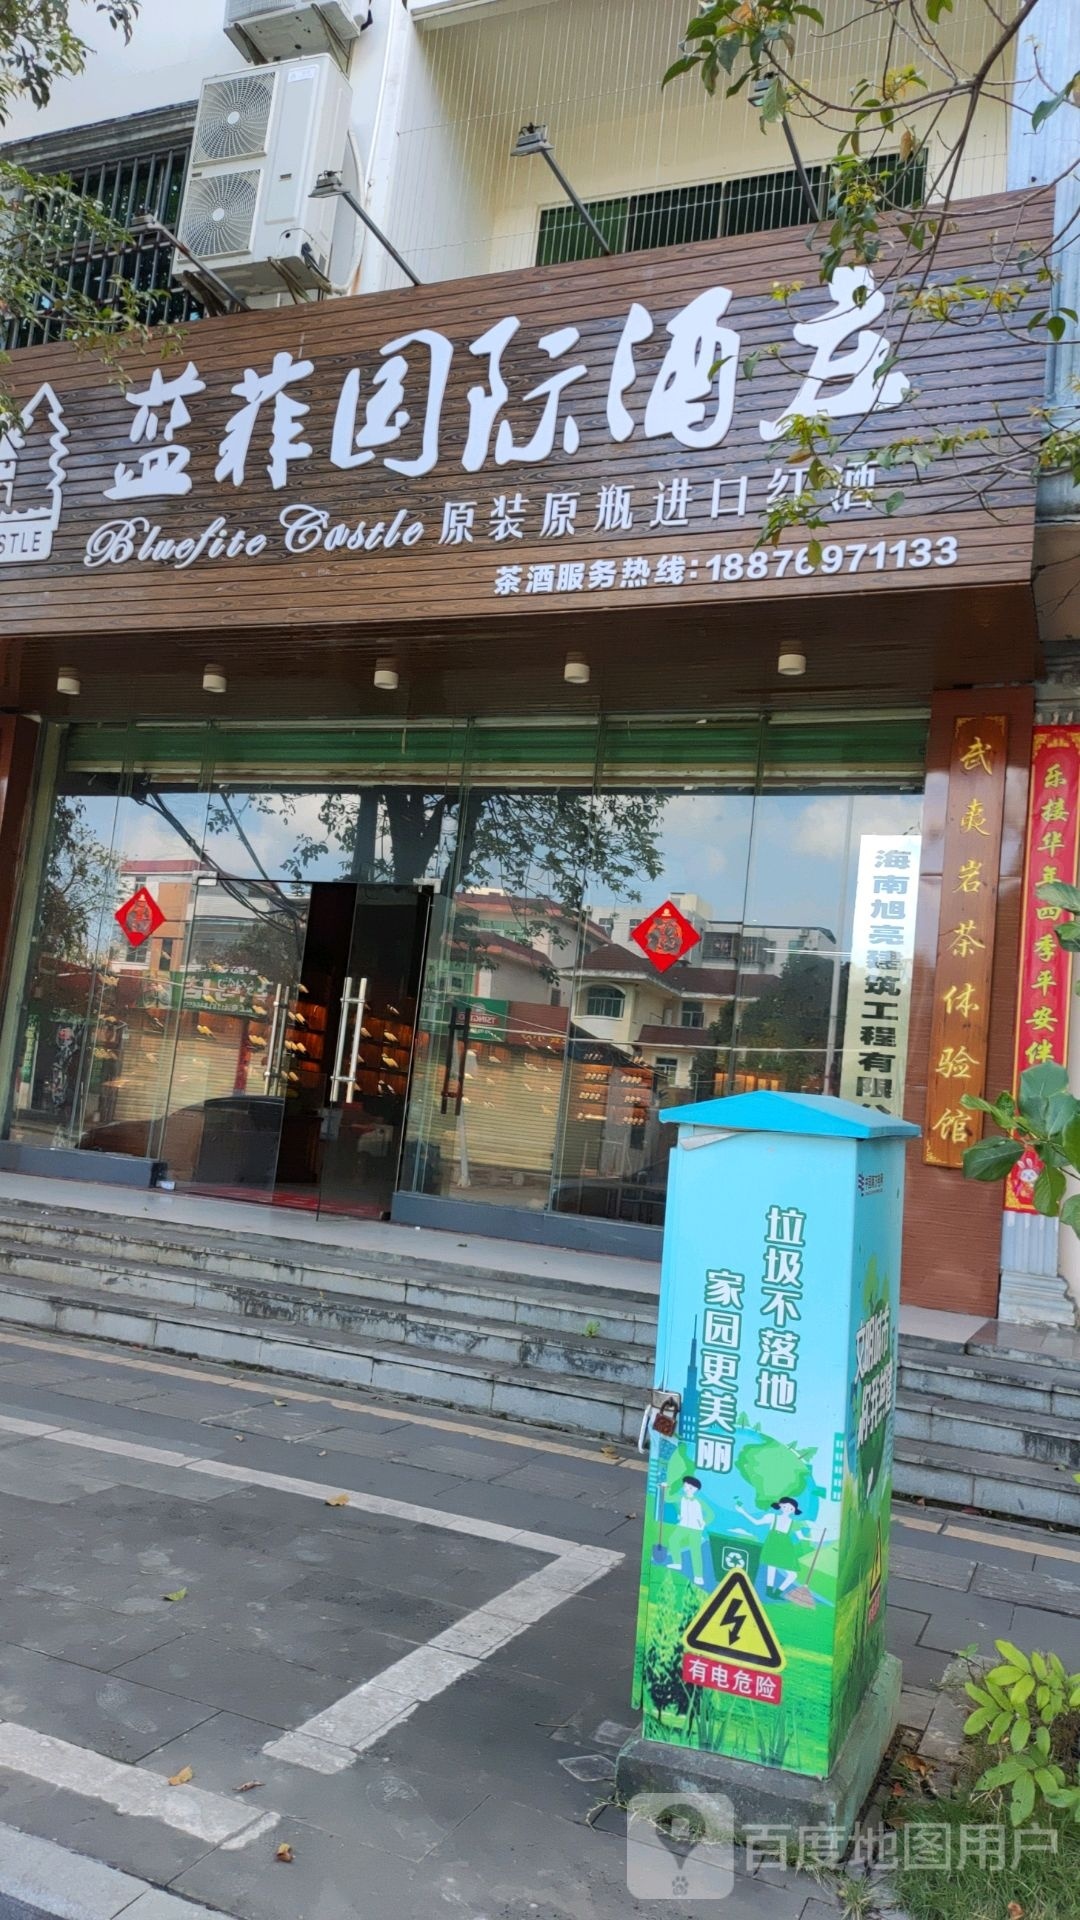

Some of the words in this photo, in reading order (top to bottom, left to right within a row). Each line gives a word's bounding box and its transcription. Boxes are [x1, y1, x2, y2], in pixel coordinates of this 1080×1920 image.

[103, 266, 911, 500] 蓝菲国际酒庄
[279, 504, 424, 553] Castle
[438, 461, 876, 545] 原装原瓶进口红酒
[932, 736, 993, 1144] 武夷岩茶体验馆
[695, 1269, 744, 1473] 家园更美丽
[755, 1205, 805, 1412] 垃圾不落地
[688, 1659, 777, 1699] 有电危险
